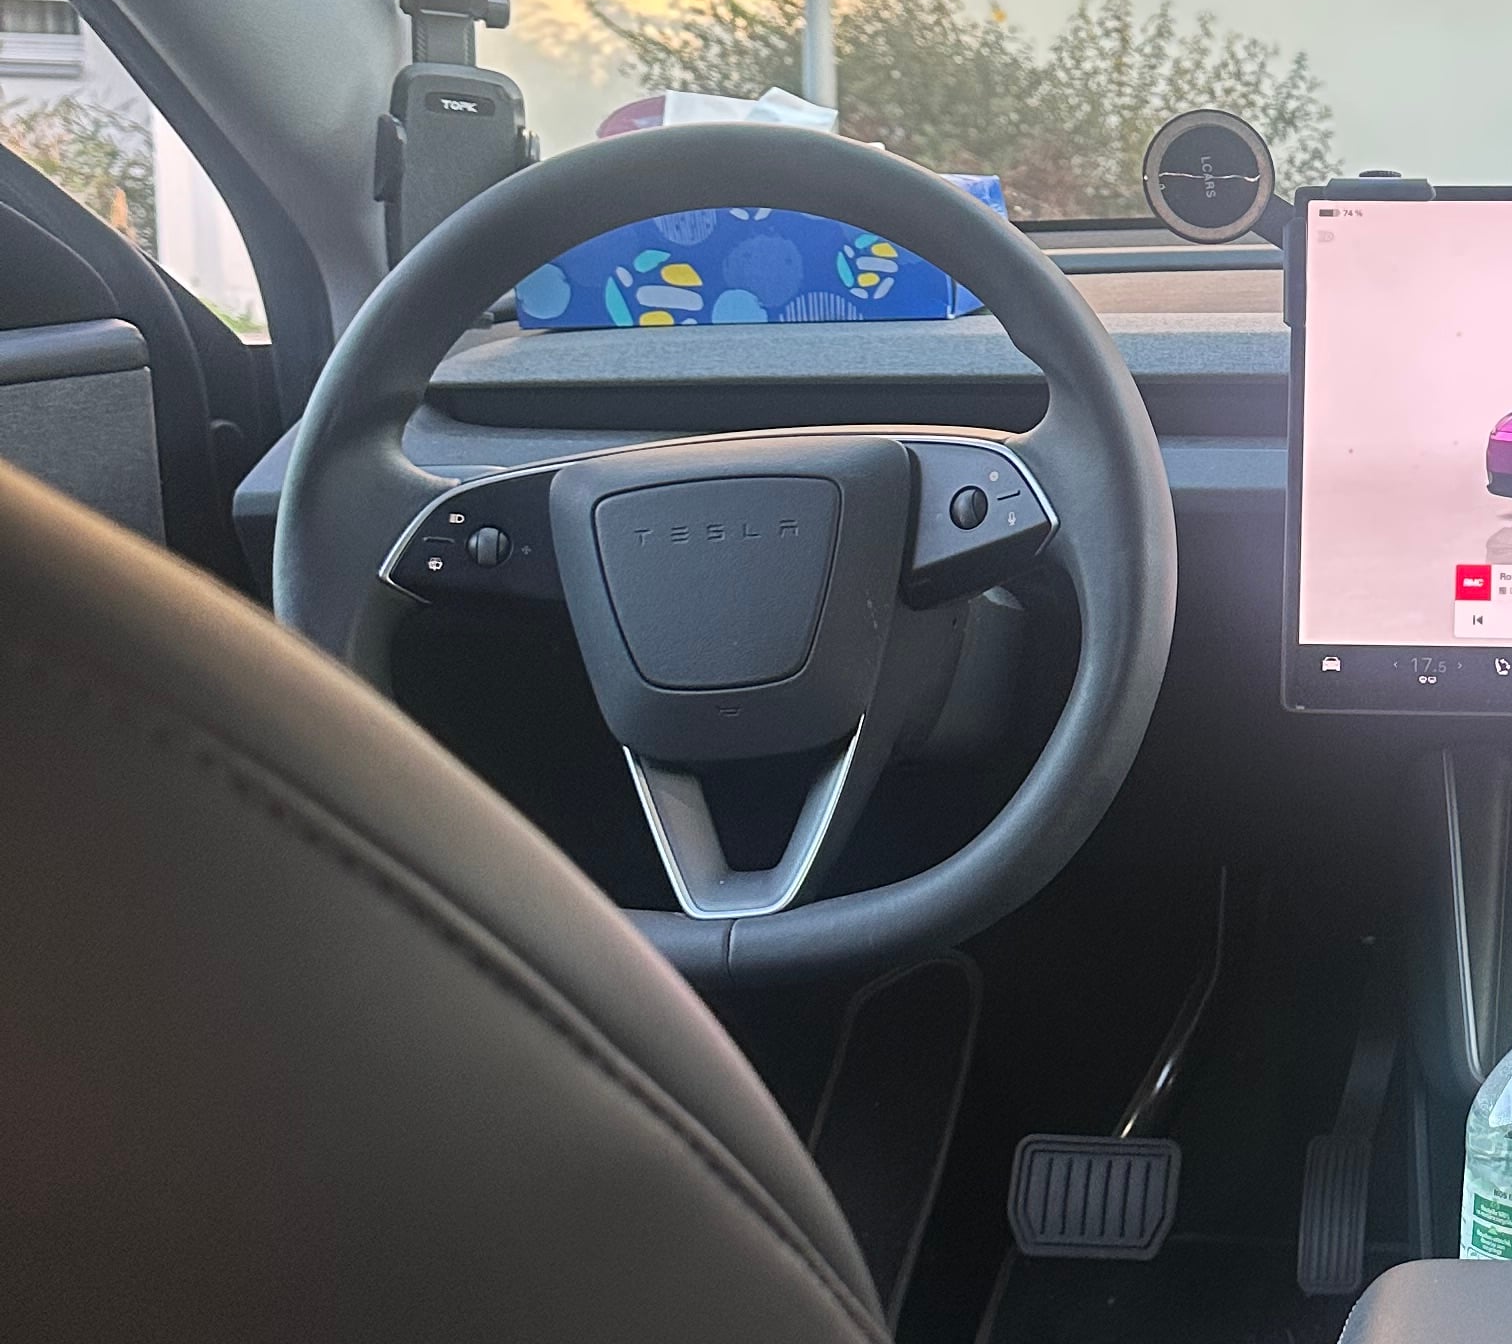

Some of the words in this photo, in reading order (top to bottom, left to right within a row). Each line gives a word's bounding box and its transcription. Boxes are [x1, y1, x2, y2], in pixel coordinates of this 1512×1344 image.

[1200, 156, 1217, 199] LCARS
[1343, 209, 1353, 217] 74
[633, 519, 799, 547] TESLA
[1410, 657, 1447, 673] 17.5
